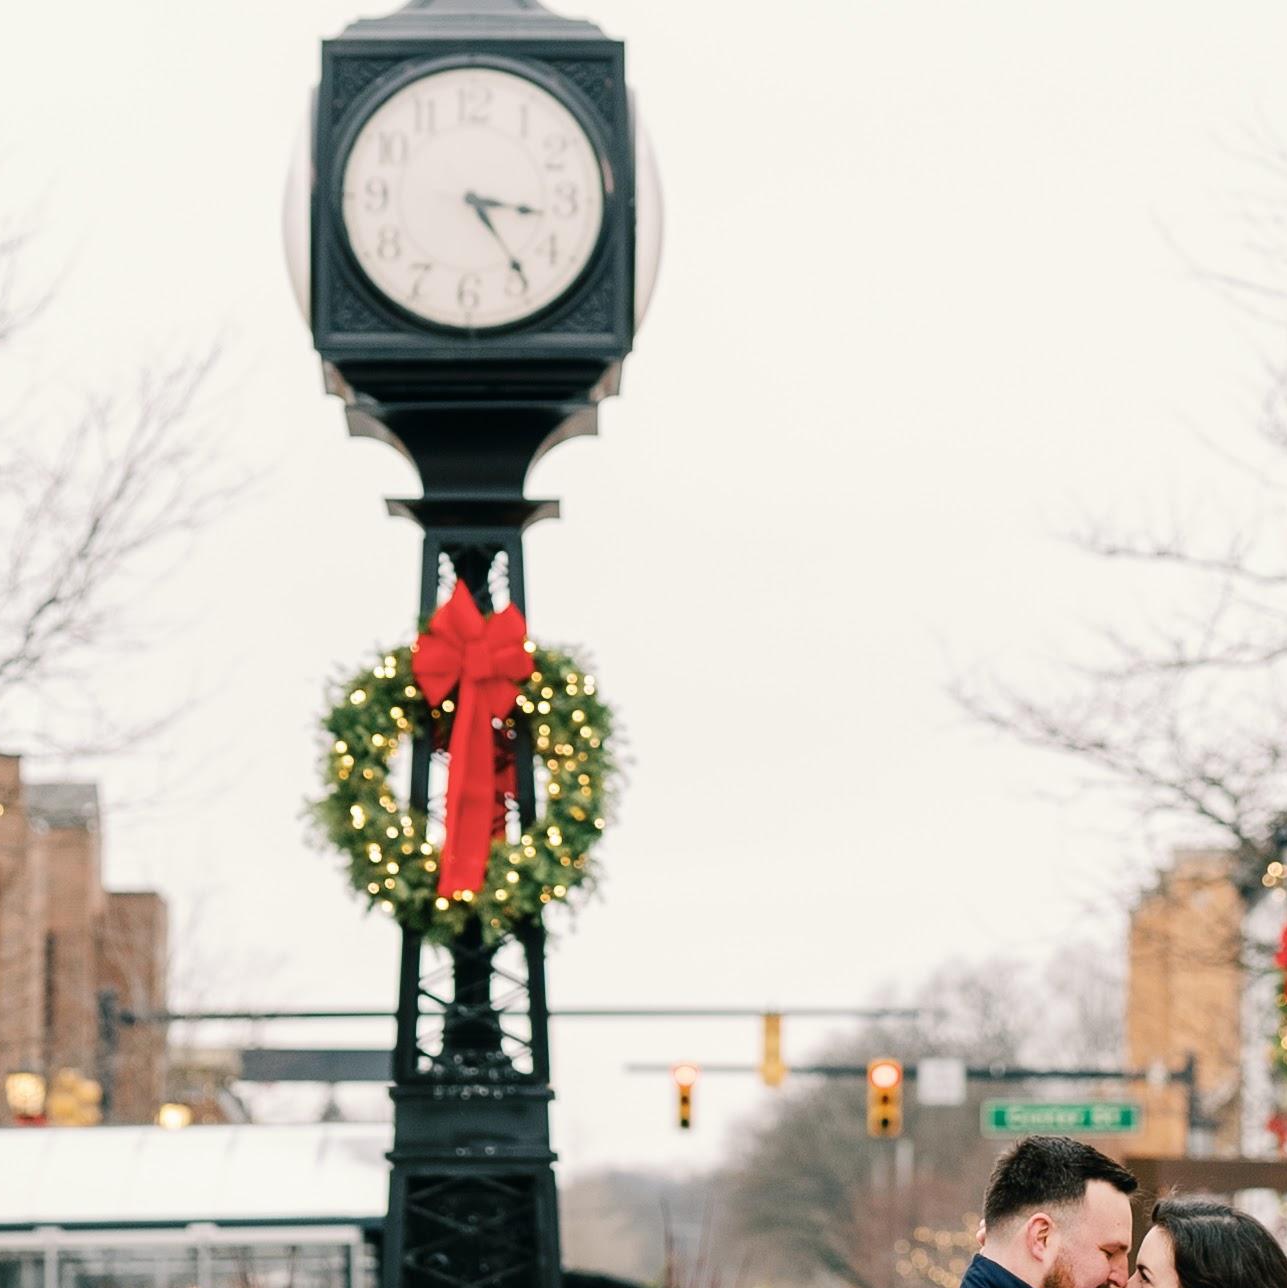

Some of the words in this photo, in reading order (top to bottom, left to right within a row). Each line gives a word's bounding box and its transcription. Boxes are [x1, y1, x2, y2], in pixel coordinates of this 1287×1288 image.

[413, 97, 437, 128] 11
[457, 87, 493, 125] 12
[517, 103, 530, 138] 1
[378, 131, 408, 166] 10
[543, 135, 569, 171] 2
[364, 177, 389, 212] 9
[554, 184, 580, 217] 3
[377, 226, 402, 261] 8
[535, 233, 560, 265] 4
[407, 263, 434, 300] 7
[457, 275, 482, 310] 6
[504, 266, 530, 297] 5
